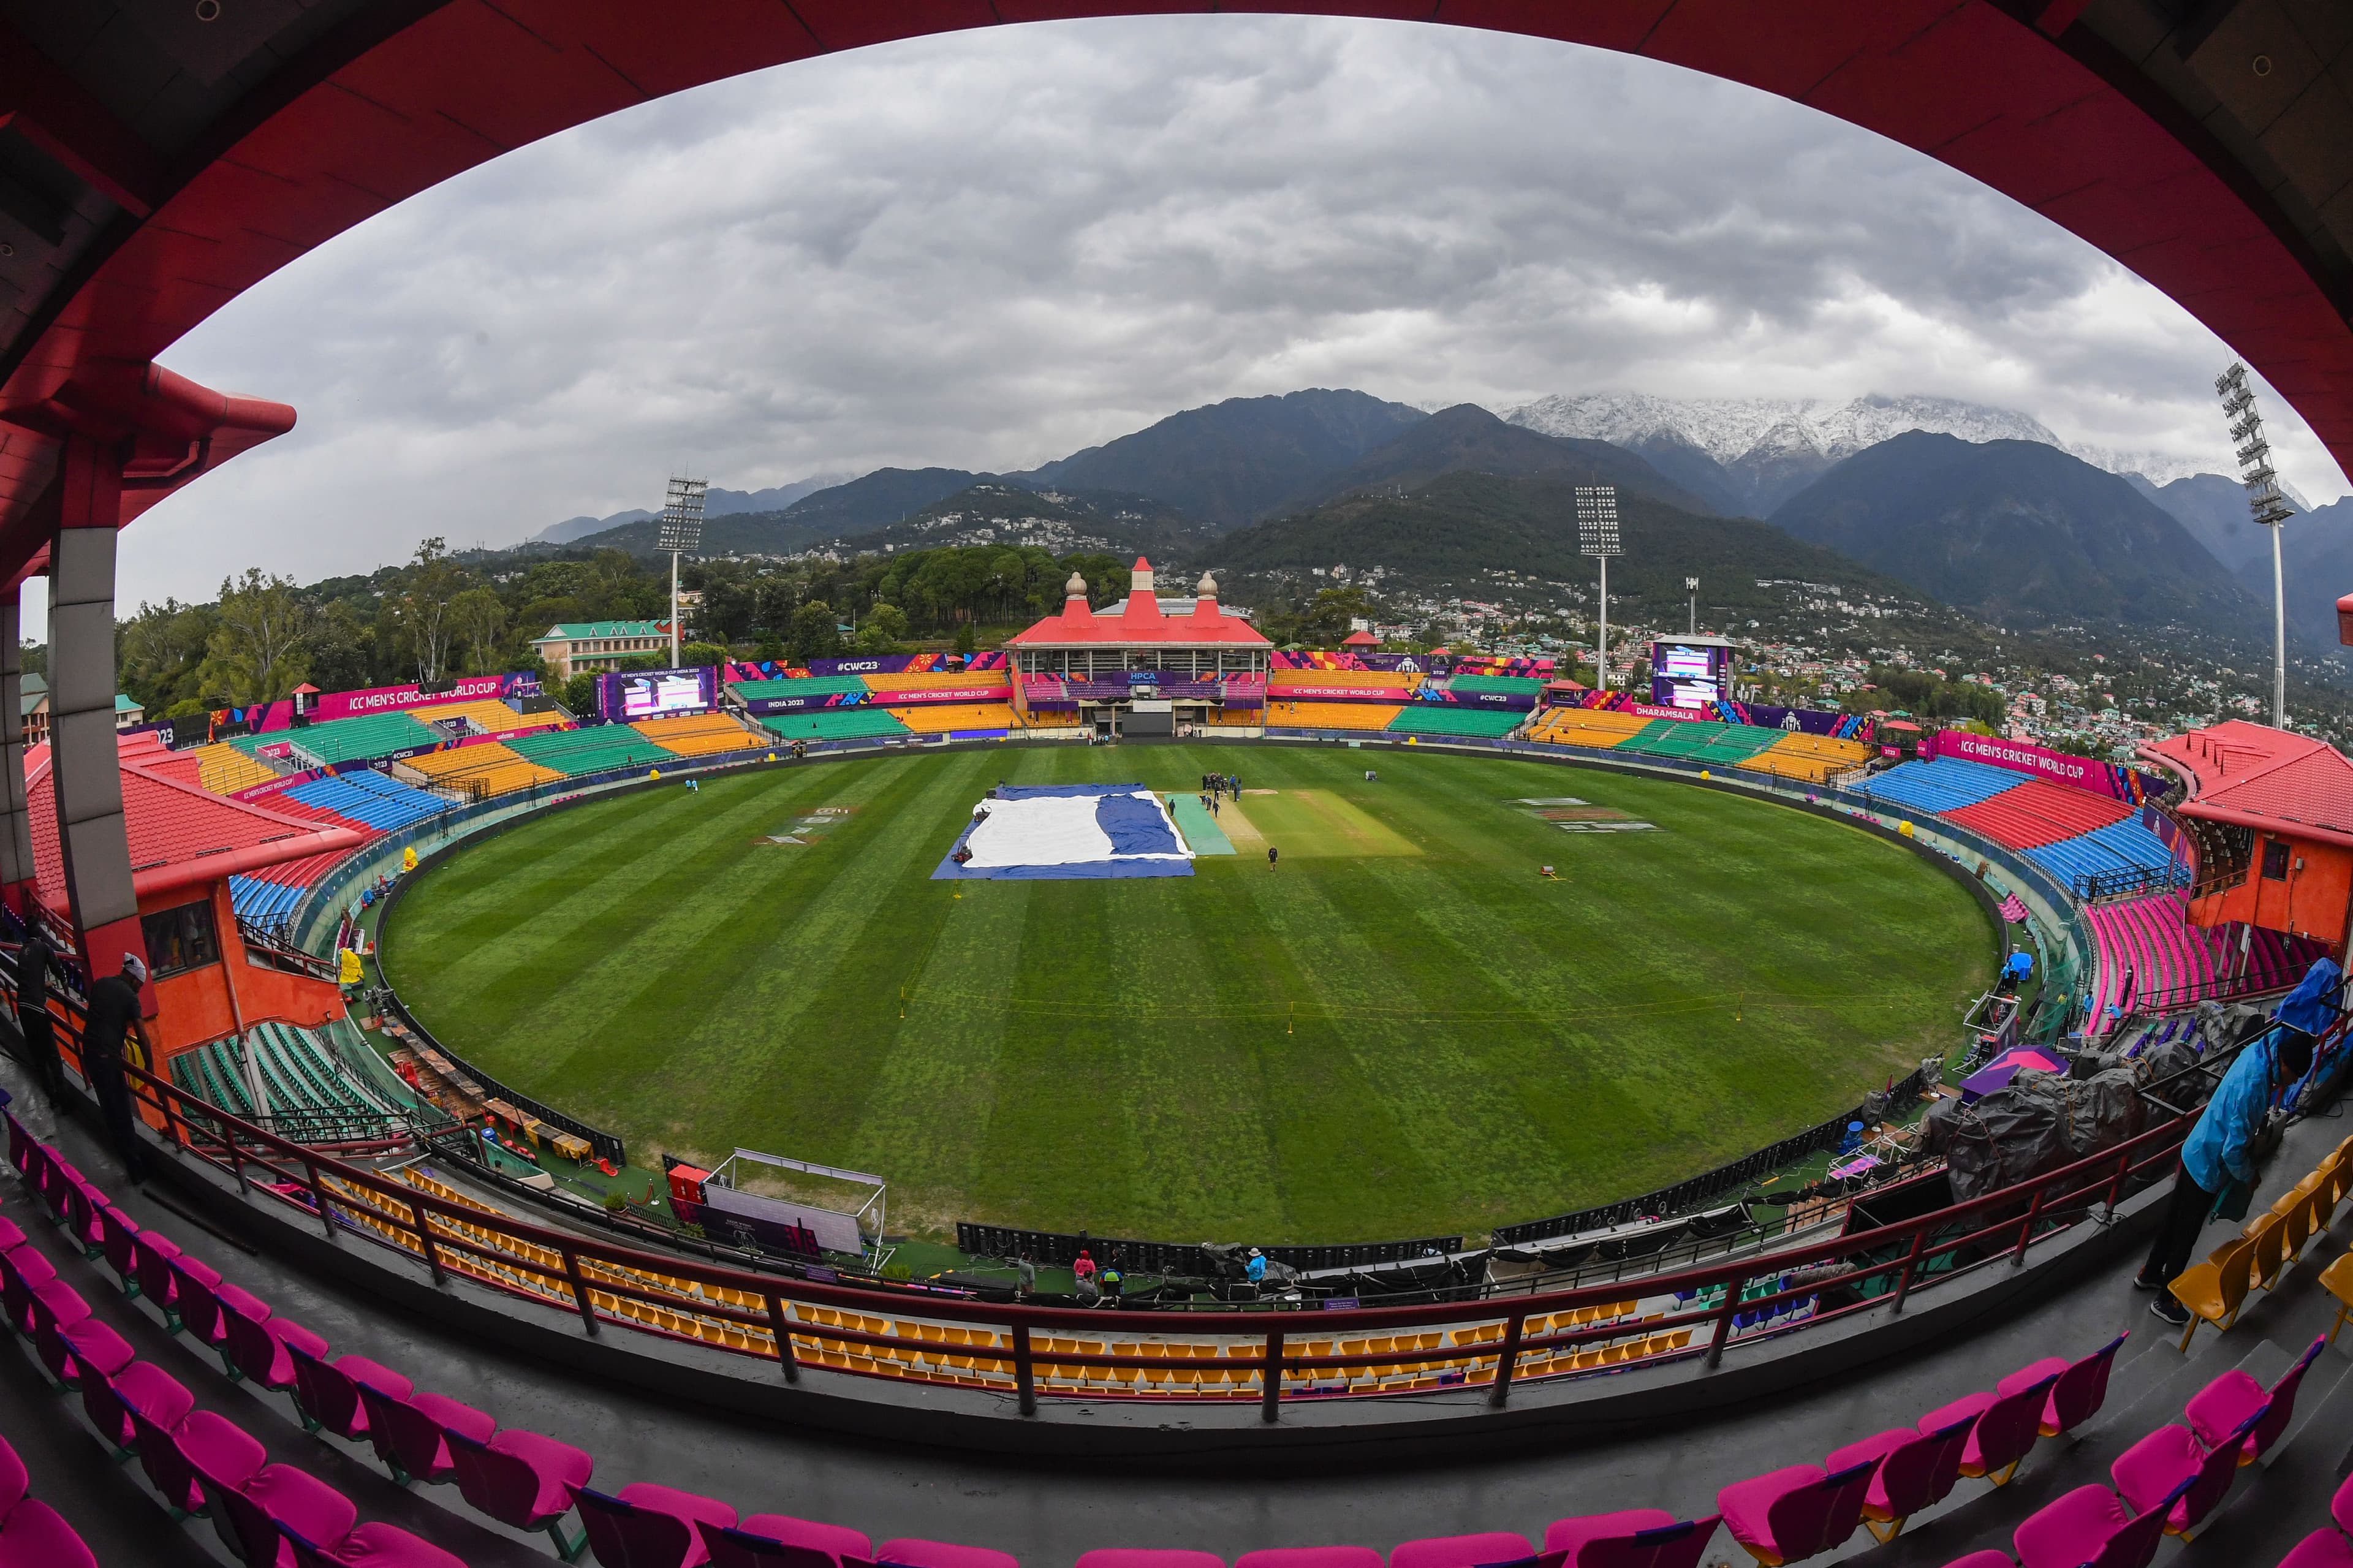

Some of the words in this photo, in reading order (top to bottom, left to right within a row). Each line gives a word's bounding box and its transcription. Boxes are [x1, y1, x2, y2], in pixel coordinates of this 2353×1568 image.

[837, 661, 878, 672] #CWC23
[349, 697, 364, 710] ICC
[366, 692, 395, 708] MEN'S
[477, 682, 496, 694] CUP
[1636, 707, 1694, 720] DHARAMSALA
[393, 751, 414, 759] #CWC23
[1961, 740, 1974, 753] ICC
[1976, 743, 2001, 759] MEN'S
[2003, 748, 2037, 767] CRICKET
[2039, 756, 2066, 775] WORLD
[2067, 764, 2084, 779] CUP
